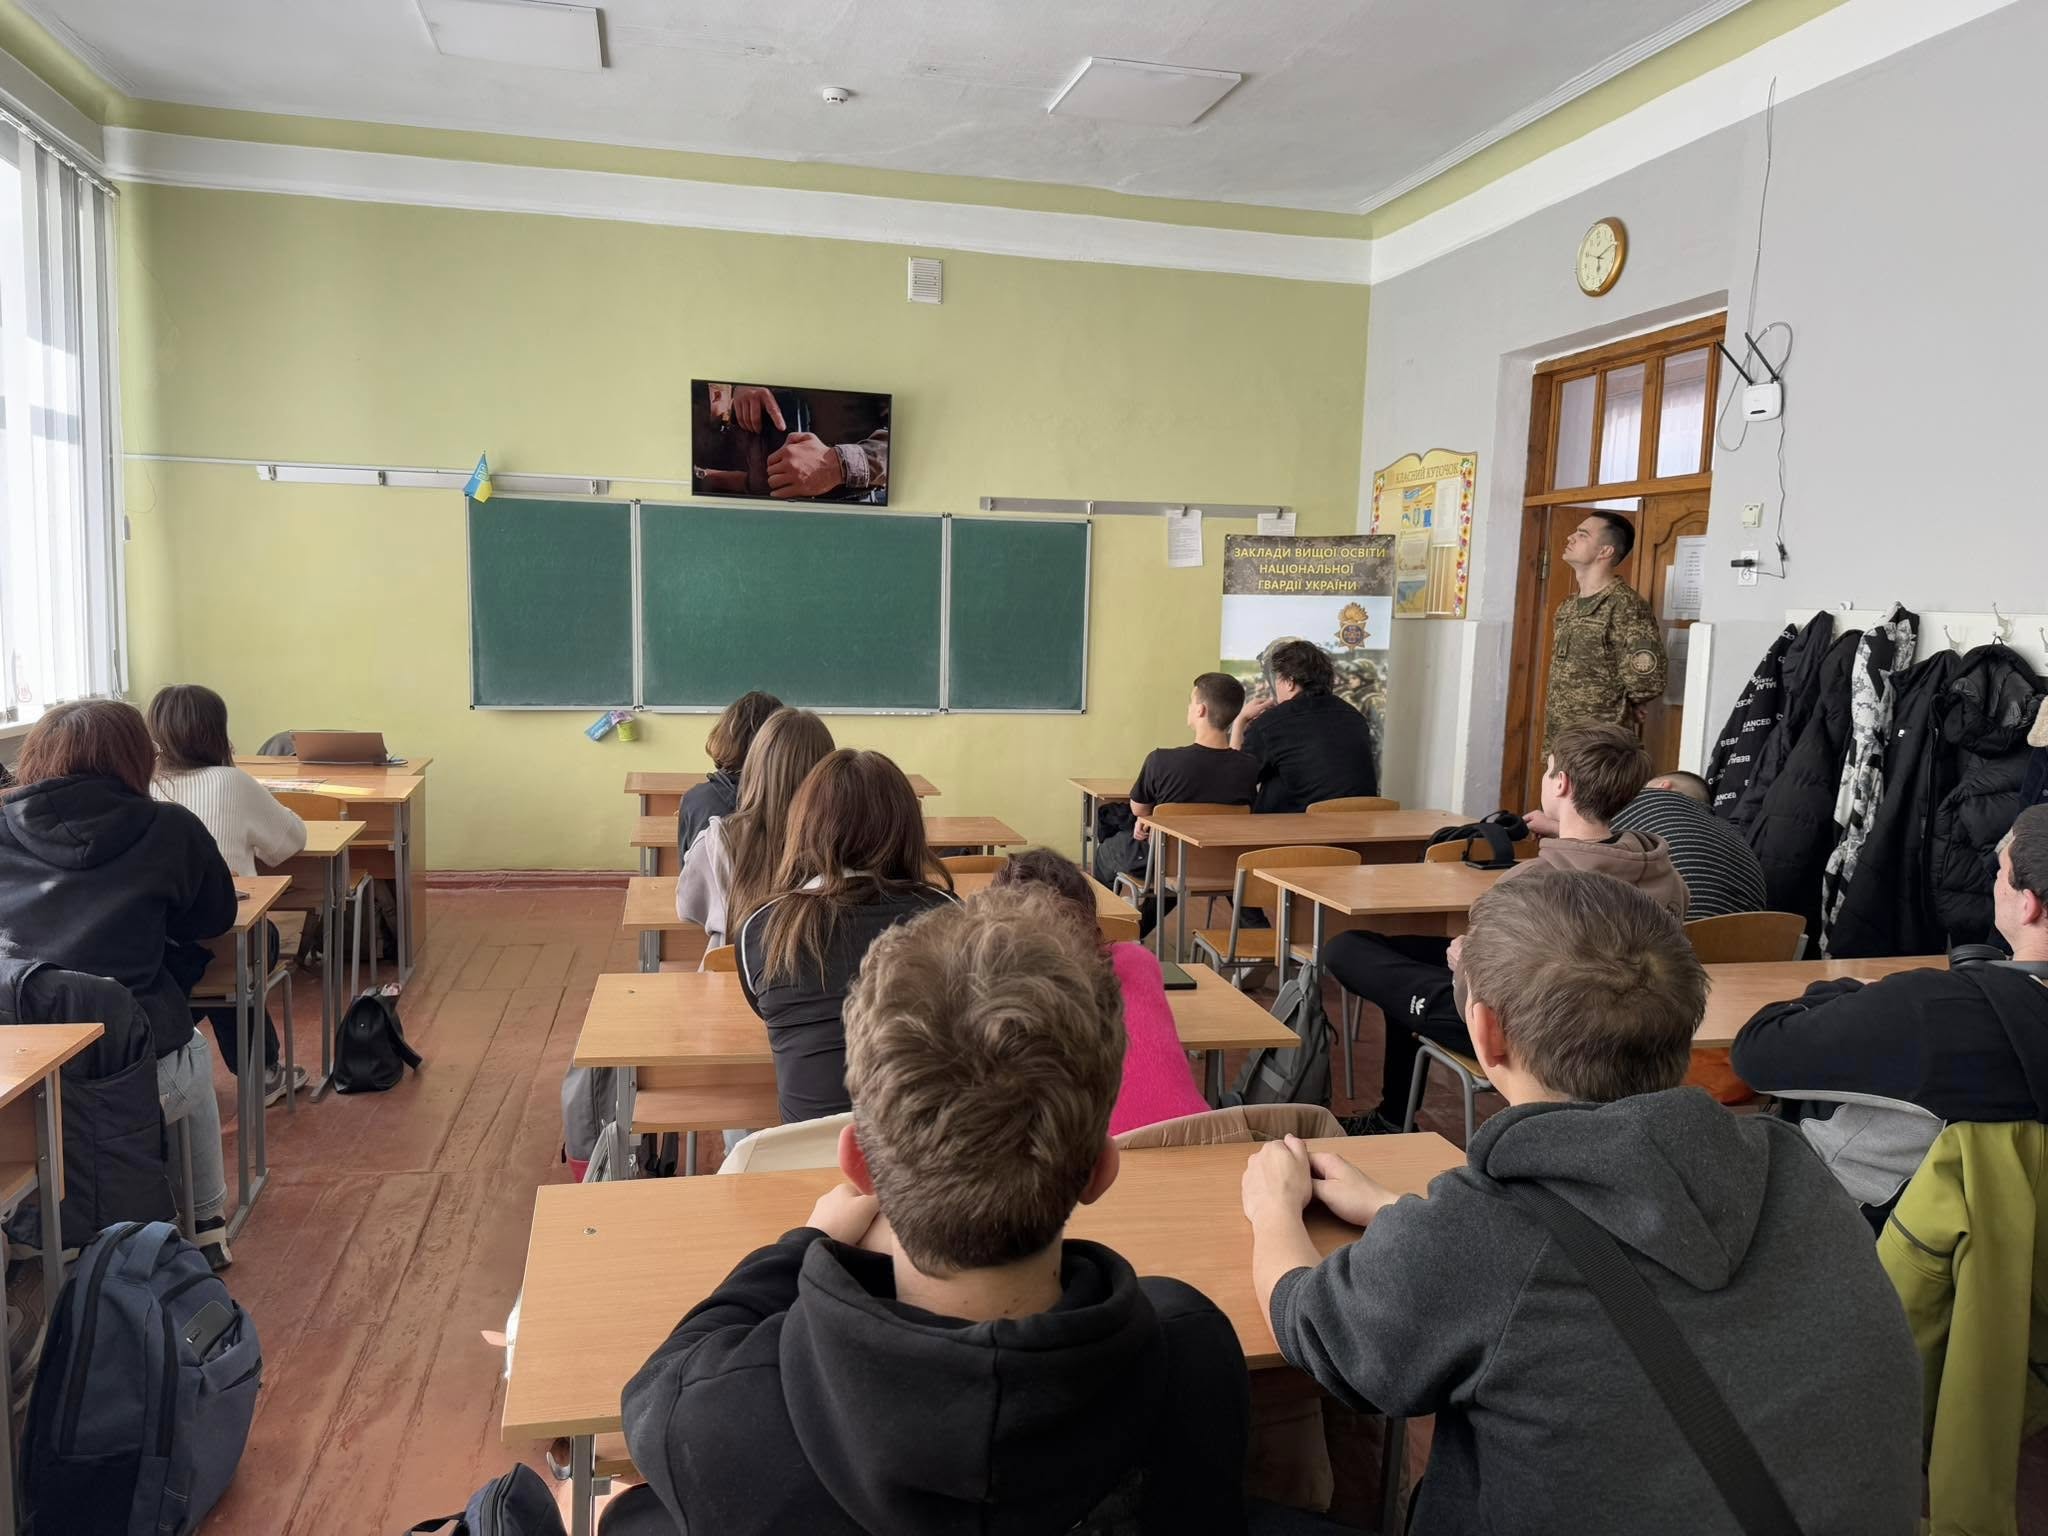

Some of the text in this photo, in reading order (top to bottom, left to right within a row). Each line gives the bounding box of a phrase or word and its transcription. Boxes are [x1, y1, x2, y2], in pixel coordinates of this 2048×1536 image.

[1234, 547, 1386, 559] ЗАКЛАДИ ВИЩОЇ ОСВІТИ
[1259, 563, 1354, 575] НАЦІОНАЛЬНОЇ
[1258, 580, 1357, 592] ГВАРДІЇ УКРАЇНИ
